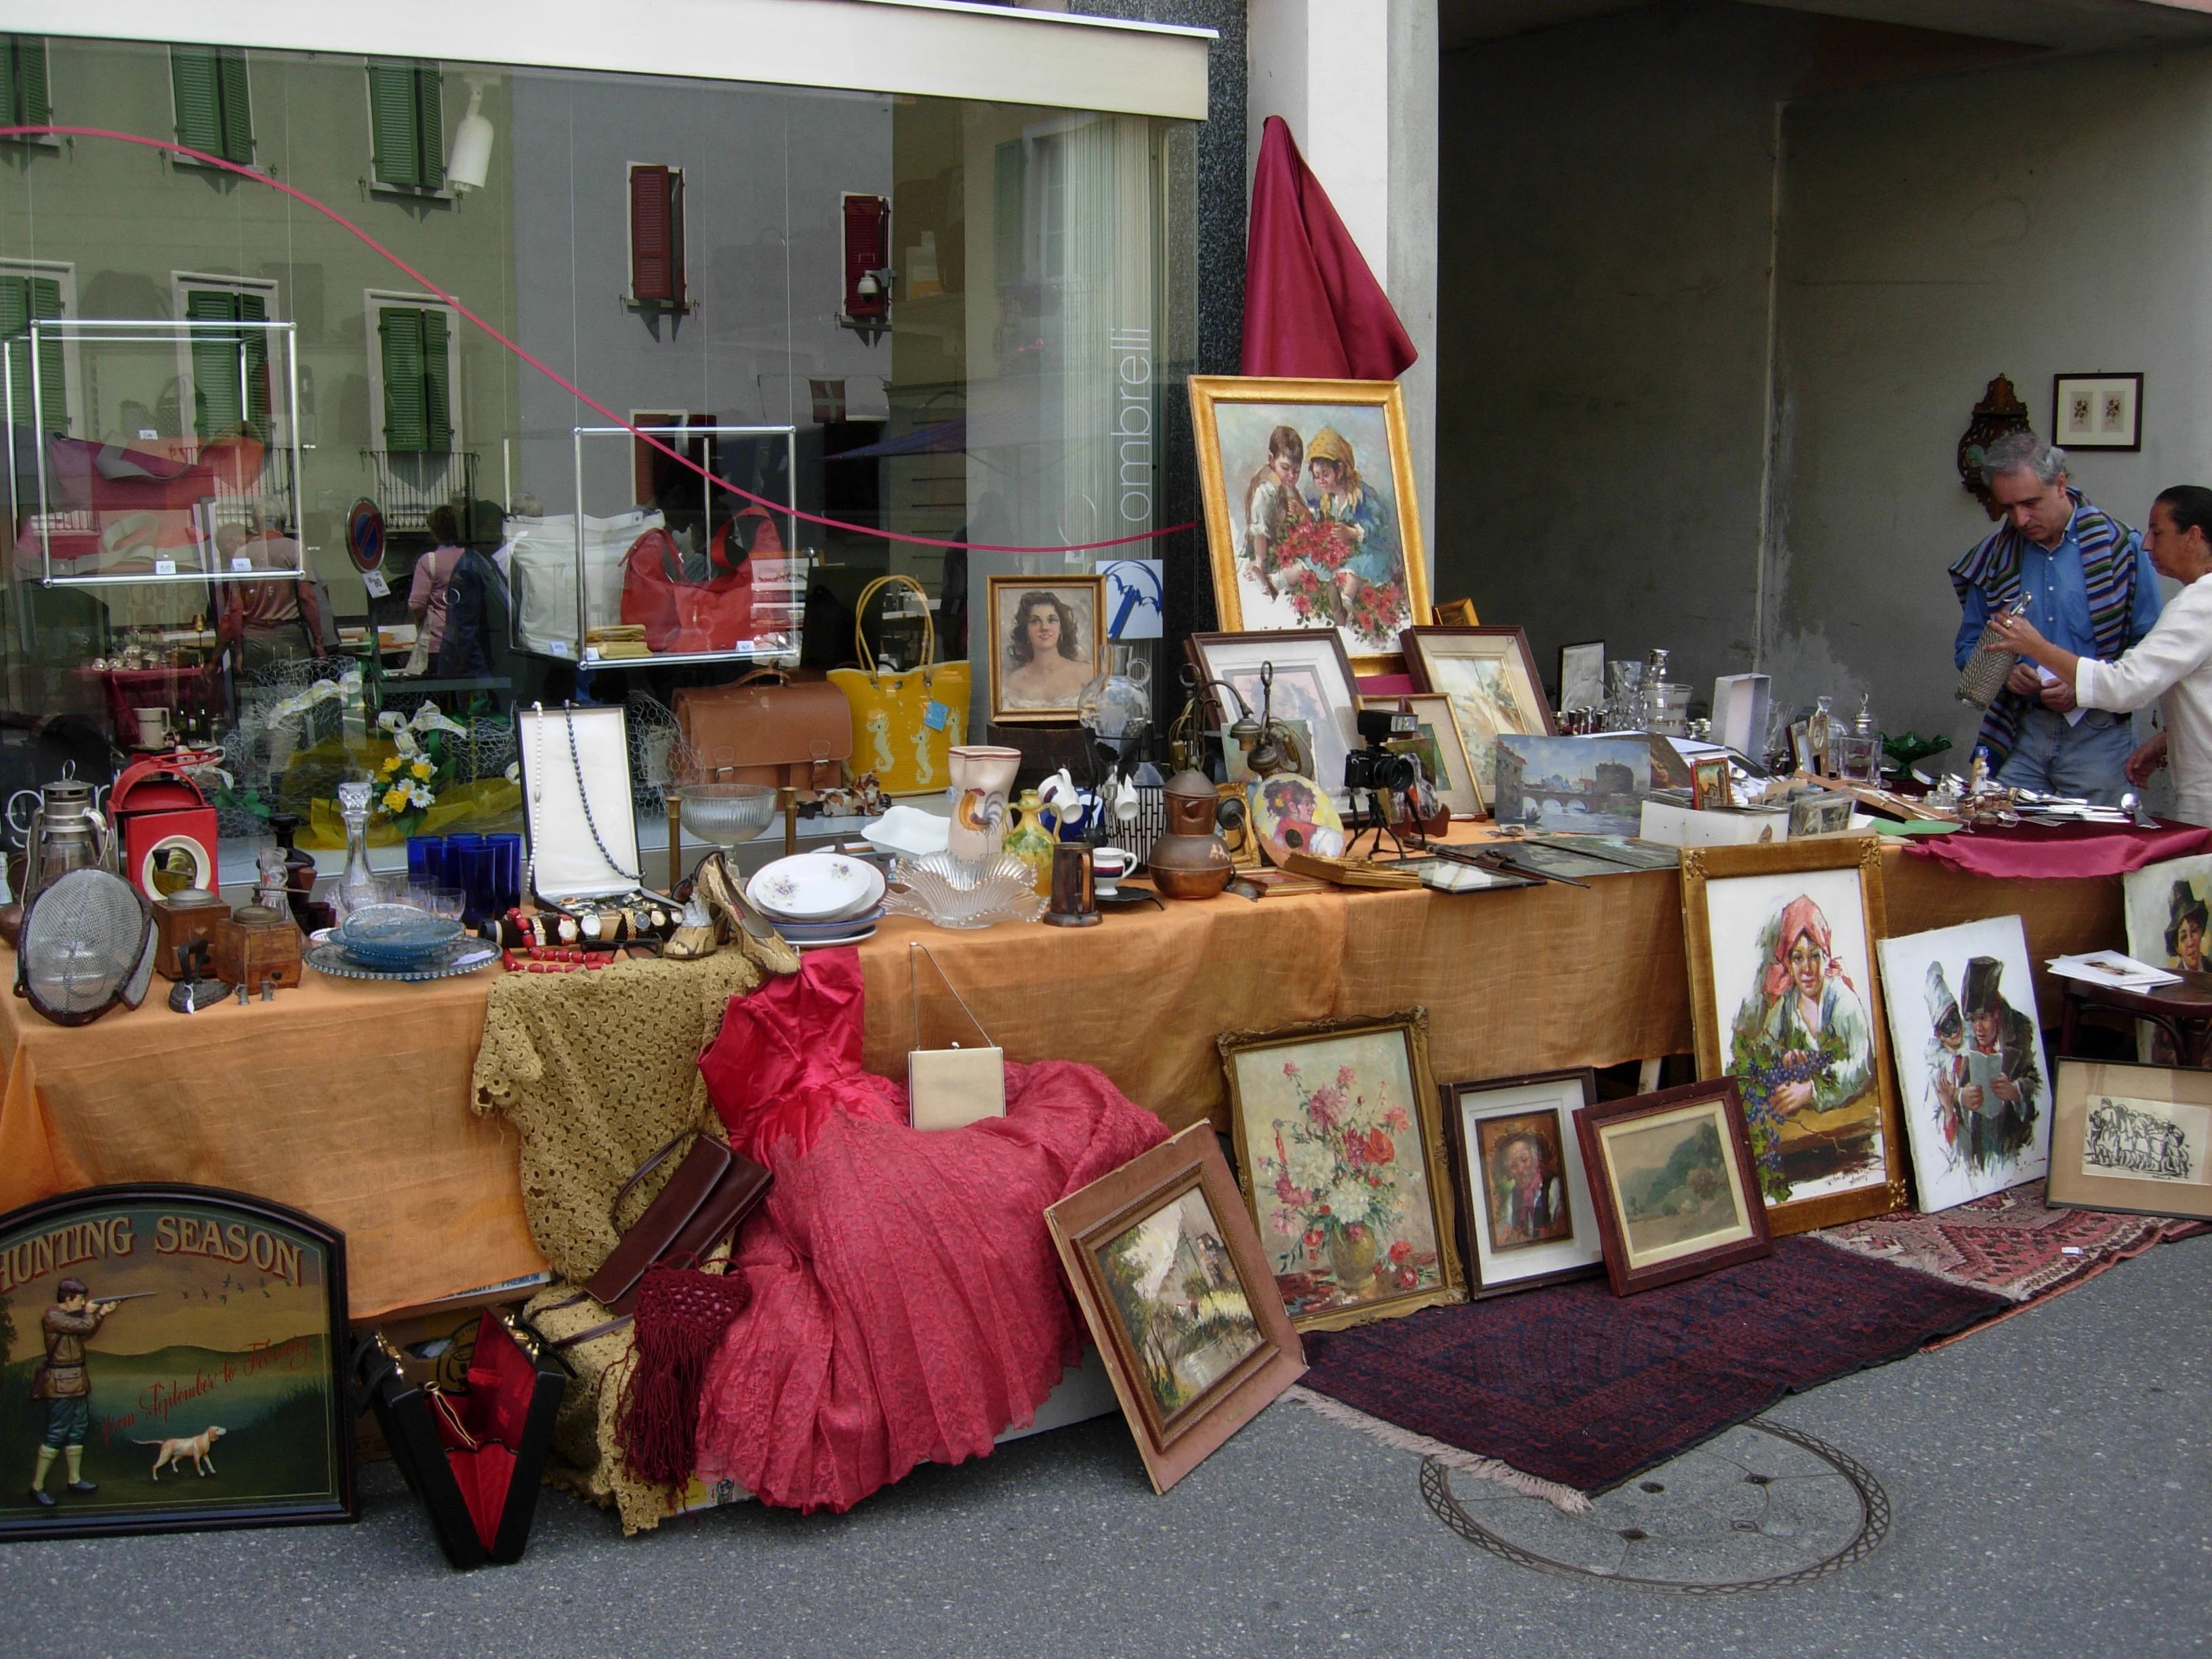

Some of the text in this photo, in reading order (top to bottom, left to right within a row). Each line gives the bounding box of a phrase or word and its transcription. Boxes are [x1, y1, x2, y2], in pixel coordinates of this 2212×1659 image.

[1110, 328, 1150, 521] ombrelli
[0, 1216, 304, 1295] HUNTING SEASON
[139, 1368, 217, 1422] September
[220, 1359, 237, 1382] to
